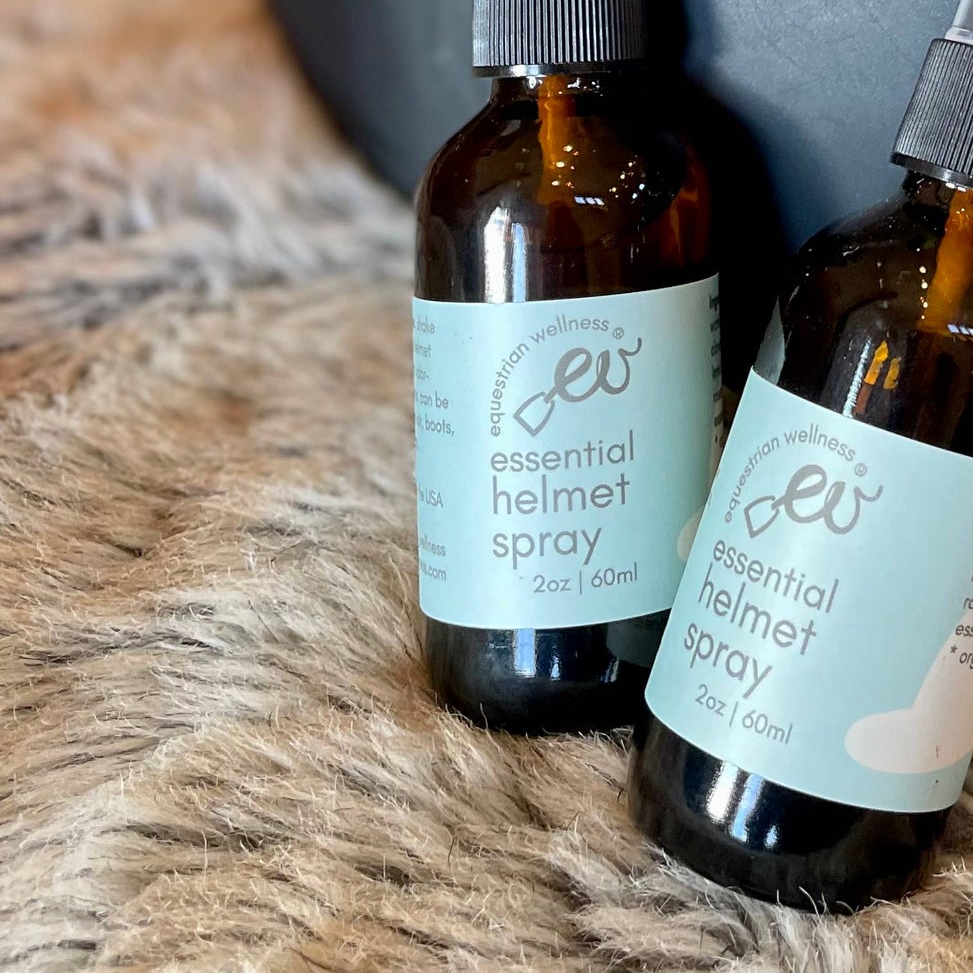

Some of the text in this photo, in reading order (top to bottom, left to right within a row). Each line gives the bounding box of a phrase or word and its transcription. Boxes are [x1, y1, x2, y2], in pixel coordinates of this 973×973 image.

[490, 343, 530, 437] equestrian
[530, 314, 610, 344] wellness
[435, 390, 449, 408] be
[425, 413, 456, 436] boots,
[490, 430, 635, 473] essential
[724, 437, 780, 523] equestrian
[783, 423, 856, 462] wellness
[425, 488, 444, 508] USA
[492, 473, 631, 516] helmet
[492, 527, 603, 570] spray
[532, 574, 572, 594] 2oz
[590, 562, 639, 589] 60ml
[713, 539, 839, 614] essential
[698, 562, 817, 656] helmet
[684, 623, 774, 700] spray
[695, 683, 728, 717] 2oz
[742, 710, 793, 746] 60ml
